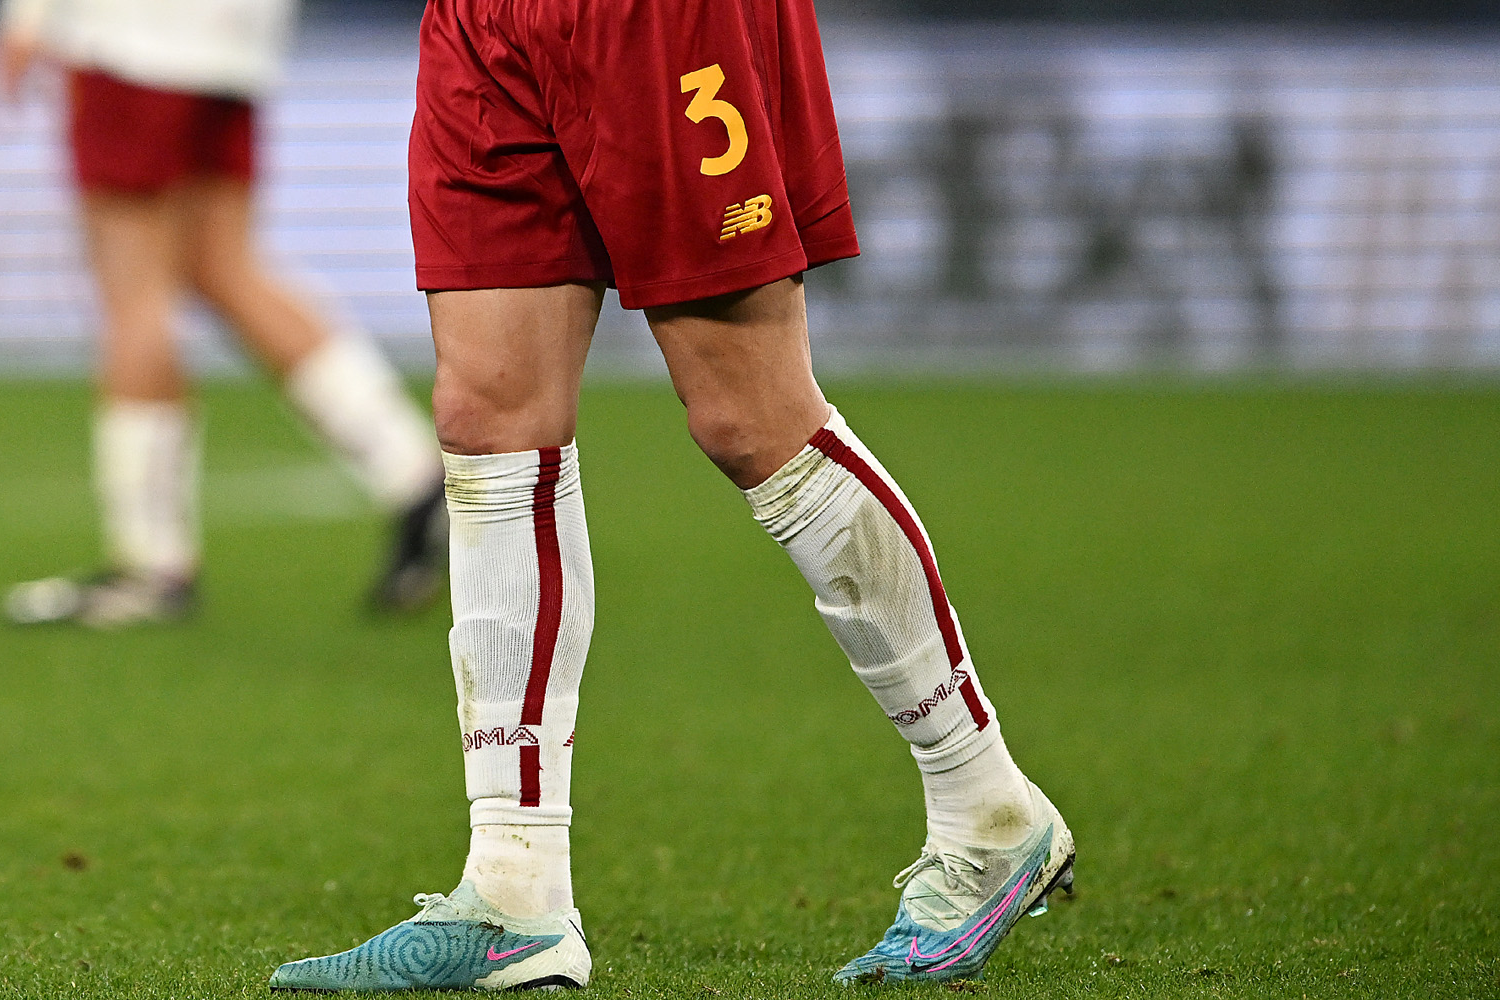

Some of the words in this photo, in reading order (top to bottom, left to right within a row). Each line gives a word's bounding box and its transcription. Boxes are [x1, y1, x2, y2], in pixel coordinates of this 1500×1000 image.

[680, 63, 749, 176] 3
[886, 669, 968, 725] OMA
[462, 727, 539, 752] OMA
